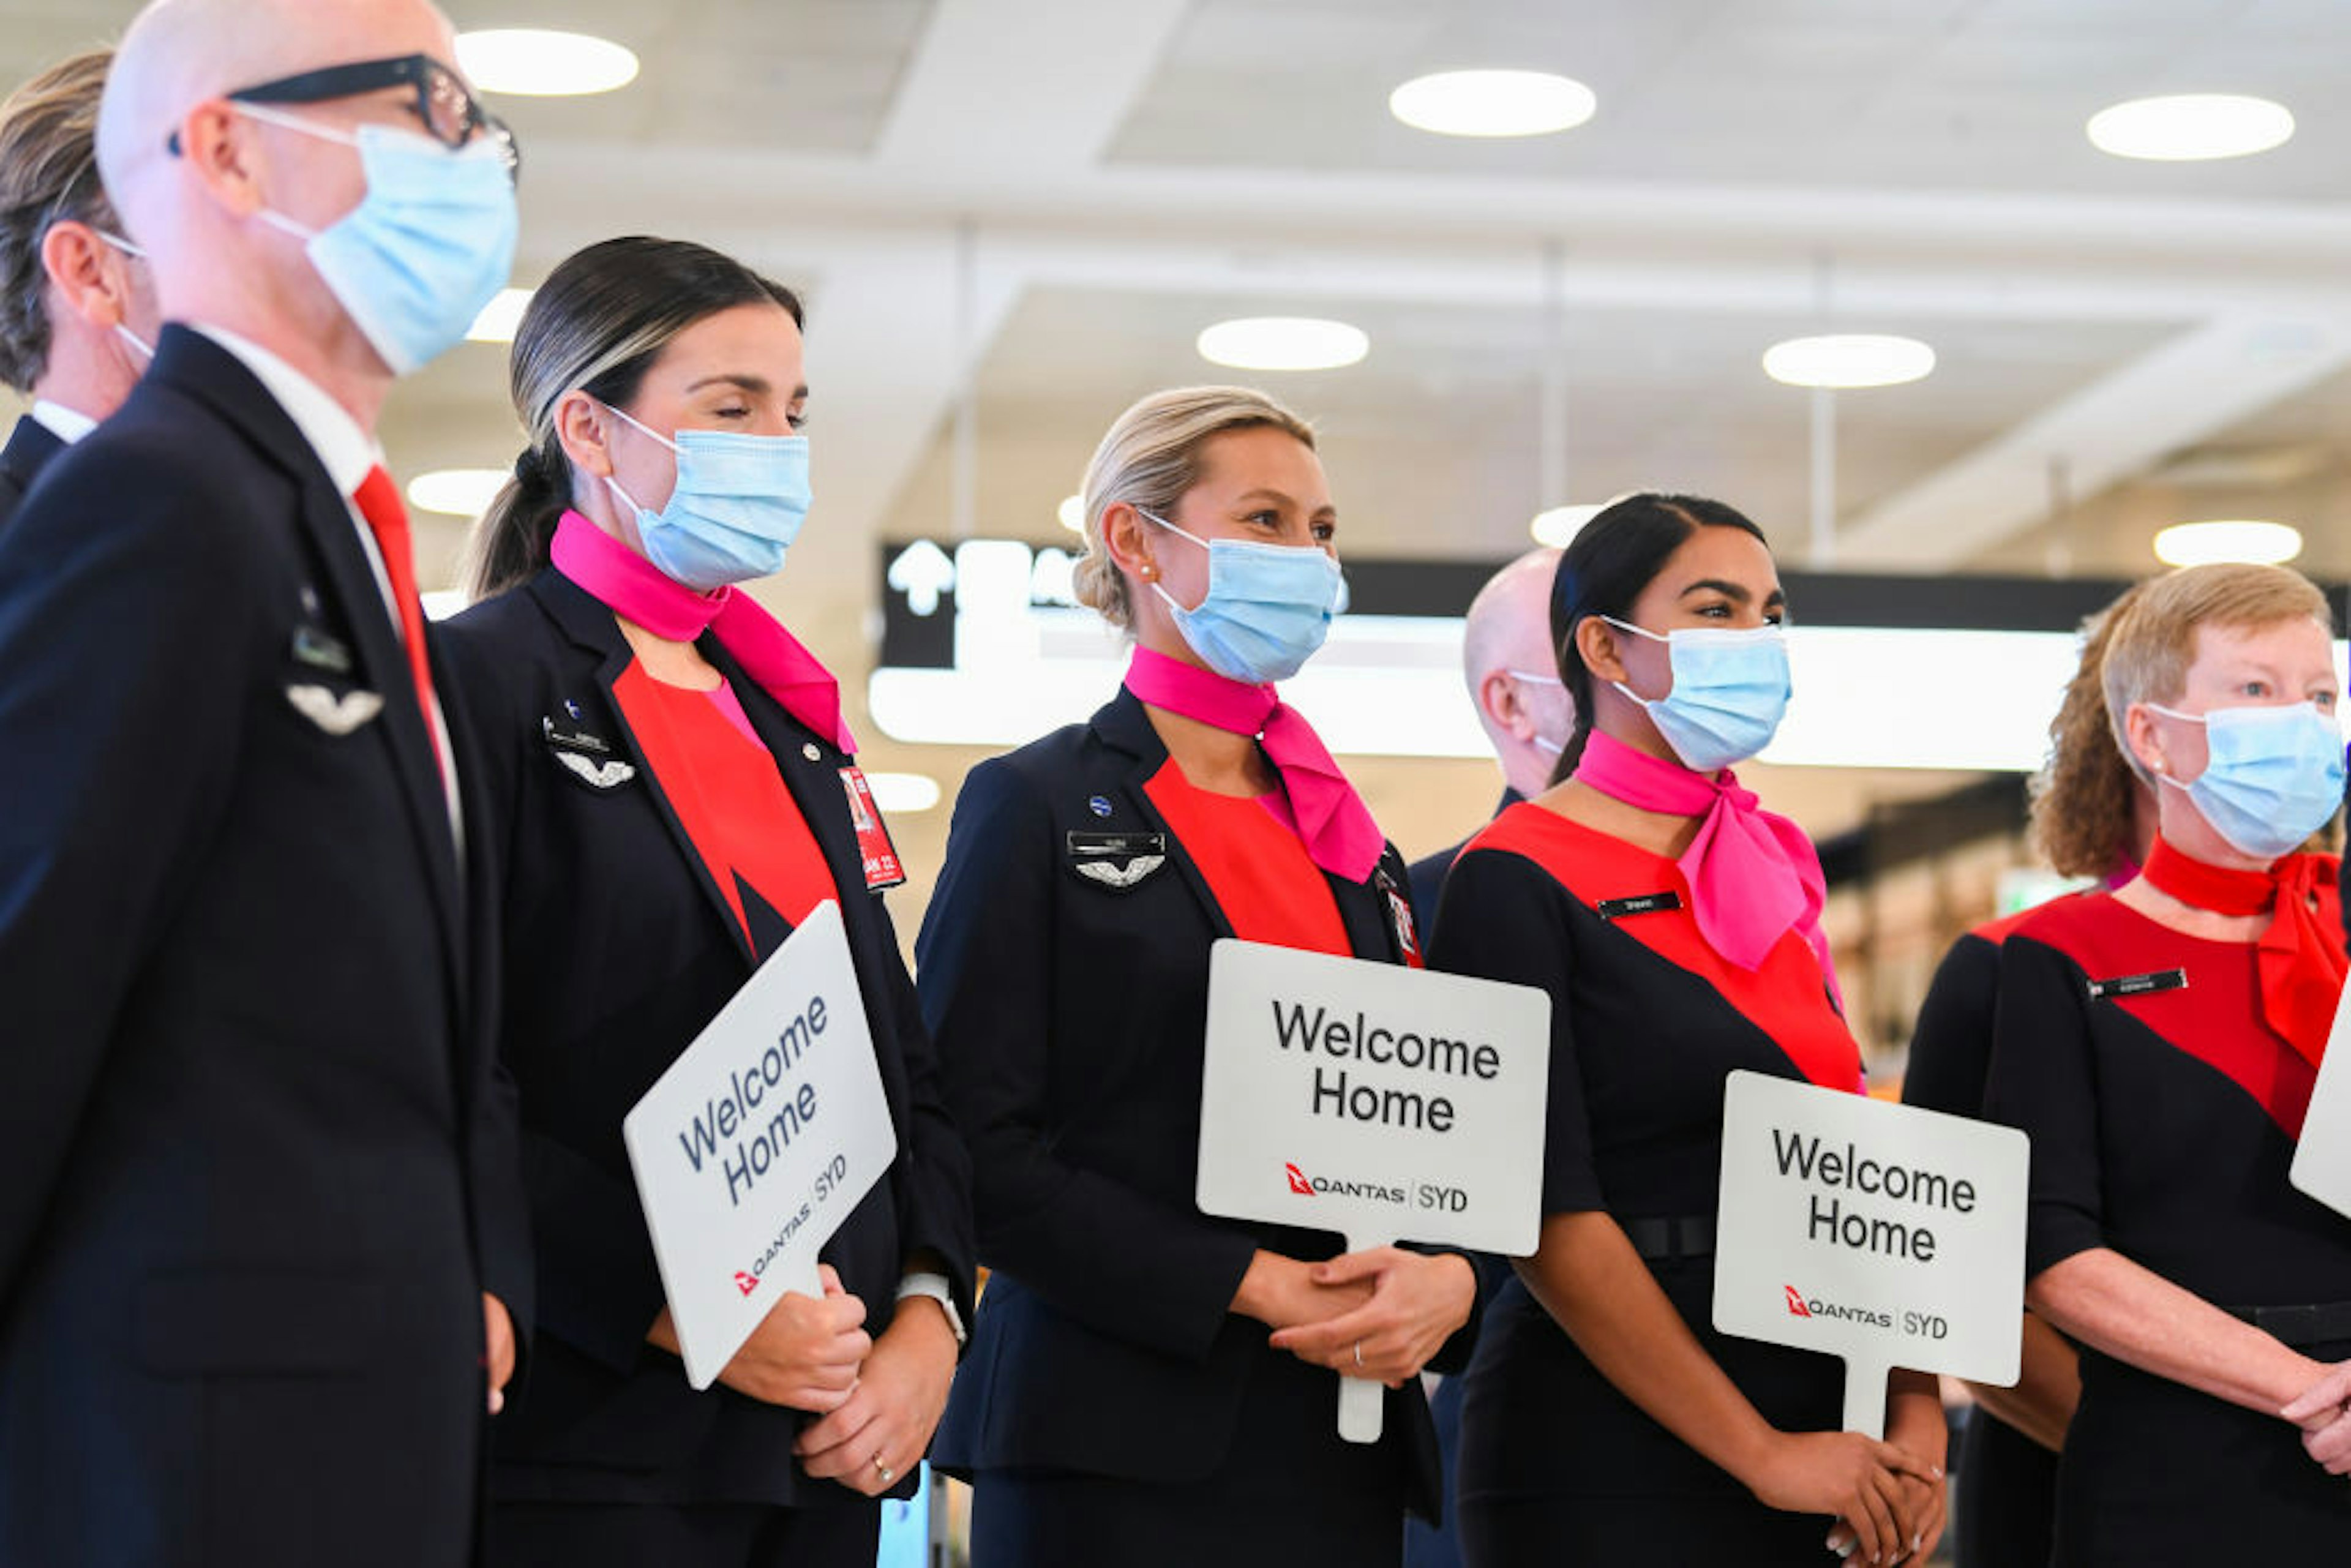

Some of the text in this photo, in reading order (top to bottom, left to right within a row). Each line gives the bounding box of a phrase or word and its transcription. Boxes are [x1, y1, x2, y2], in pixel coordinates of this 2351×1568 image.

[1272, 1000, 1500, 1080] Welcome
[679, 995, 827, 1172] Welcome
[1313, 1067, 1454, 1133] Home
[724, 1082, 816, 1206] Home
[1772, 1128, 1975, 1213] Welcome
[753, 1153, 846, 1277] QANTAS SYD
[1312, 1177, 1468, 1213] QANTAS SYD
[1809, 1194, 1935, 1262] Home
[1809, 1300, 1948, 1340] QANTAS SYD
